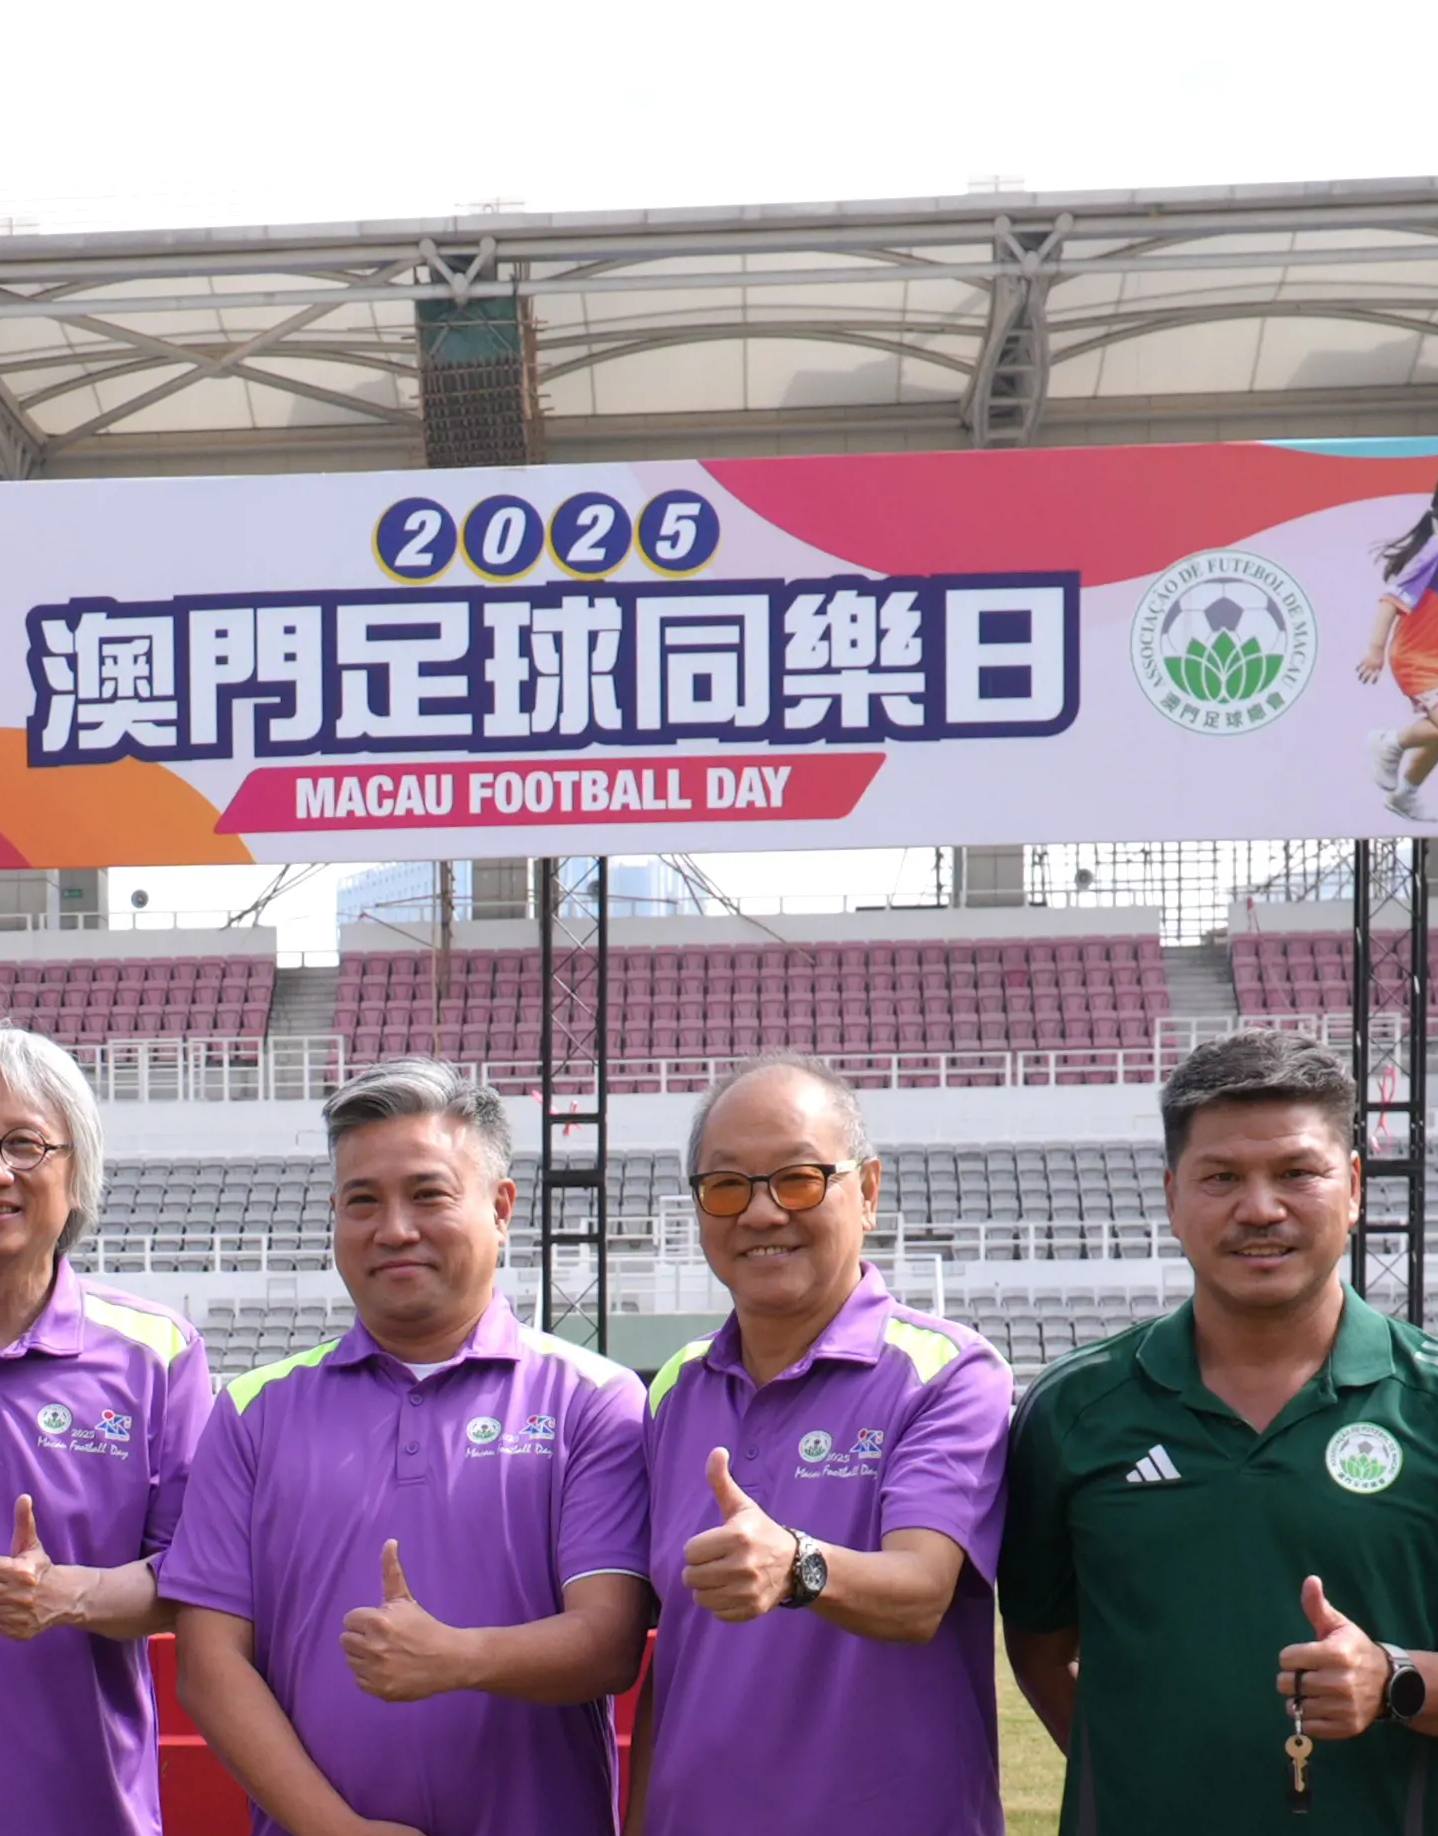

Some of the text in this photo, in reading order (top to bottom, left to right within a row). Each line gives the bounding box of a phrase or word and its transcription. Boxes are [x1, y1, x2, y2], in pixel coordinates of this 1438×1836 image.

[393, 502, 701, 567] 2025
[42, 586, 1067, 750] 澳門足球同樂日
[1140, 557, 1309, 689] ASSOCIAÇÃO DE FUTEBOL DE MACAU
[295, 766, 793, 819] MACAU FOOTBALL DAY
